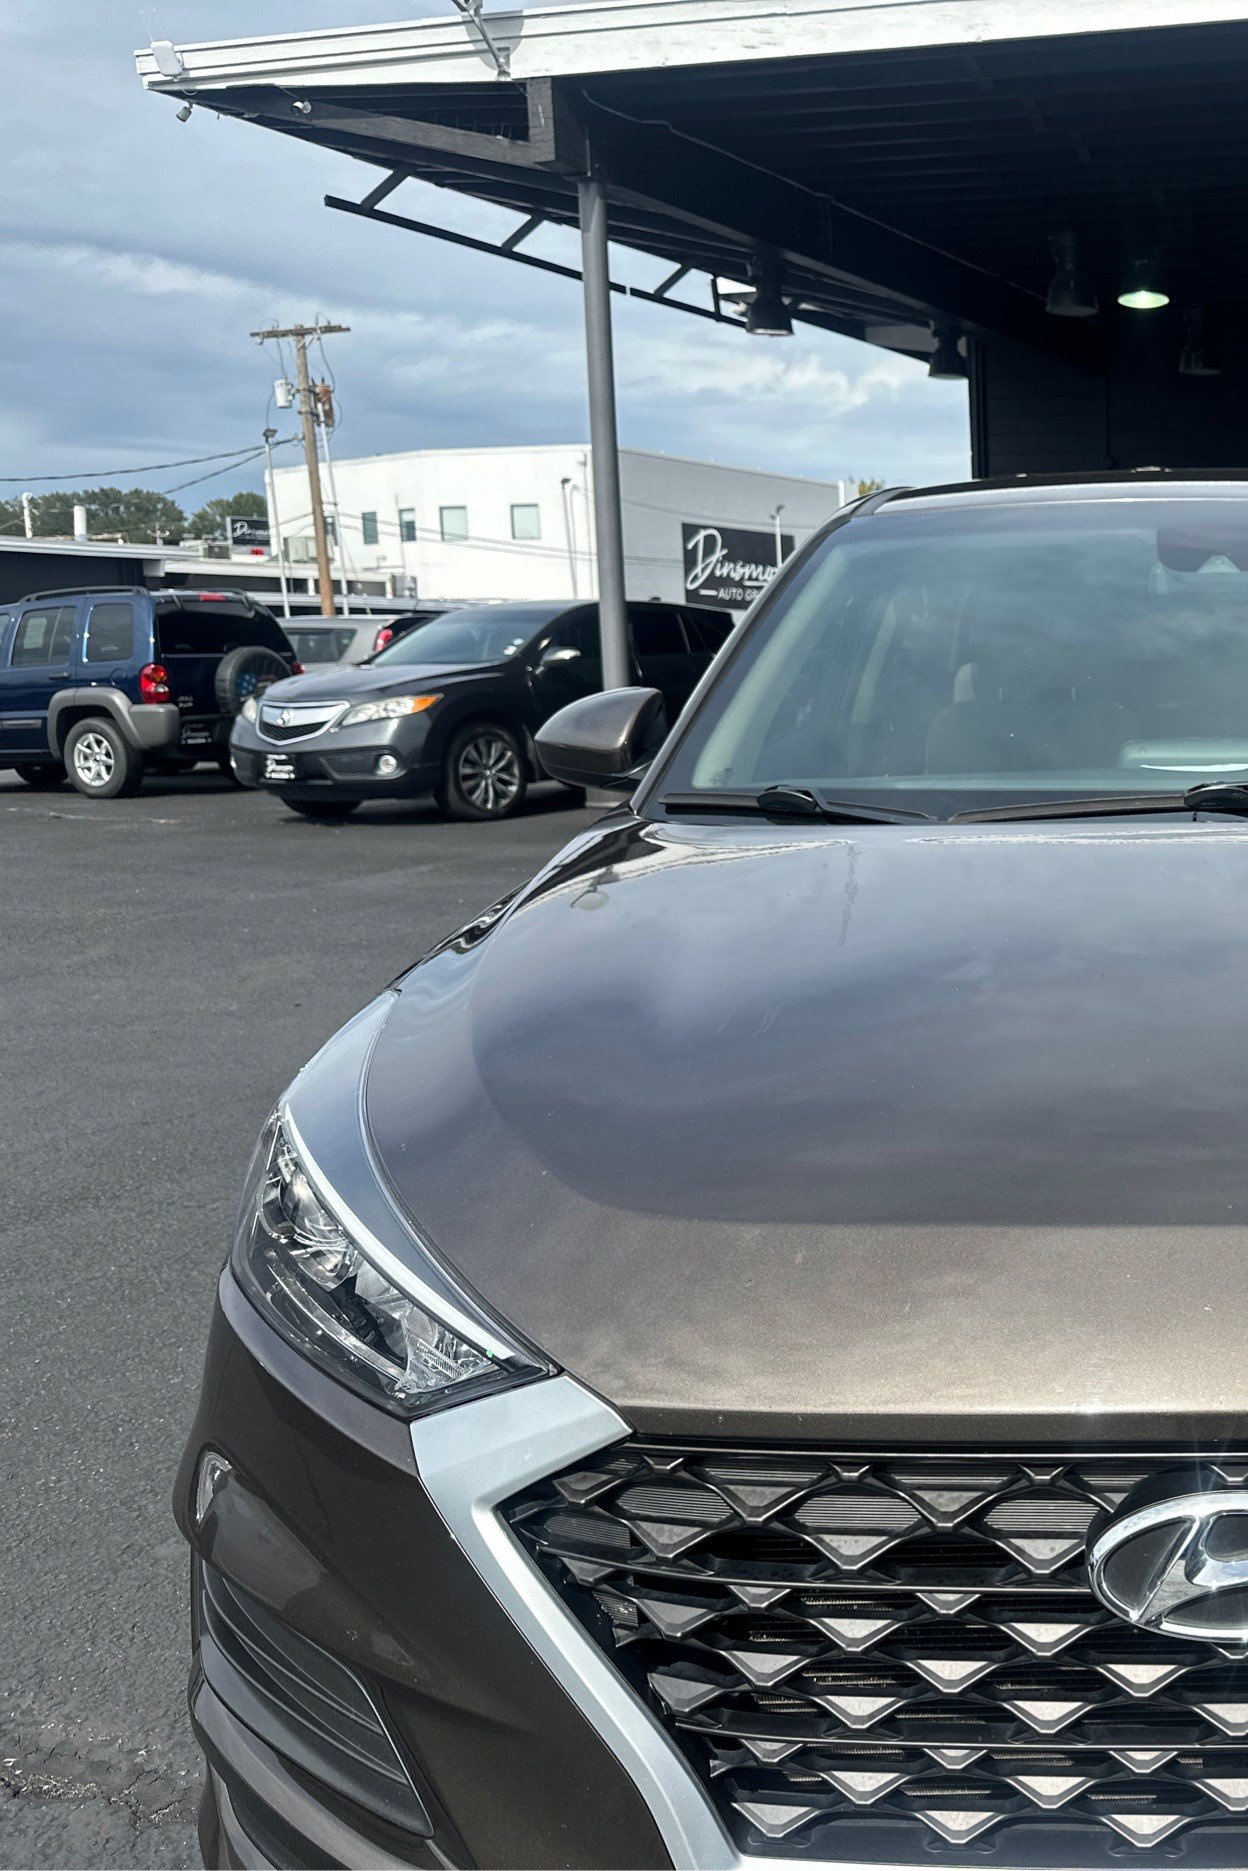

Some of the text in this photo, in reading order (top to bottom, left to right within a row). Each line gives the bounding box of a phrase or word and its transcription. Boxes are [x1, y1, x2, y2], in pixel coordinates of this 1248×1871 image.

[686, 528, 779, 590] Dinsmo
[718, 587, 759, 602] AUTO GR
